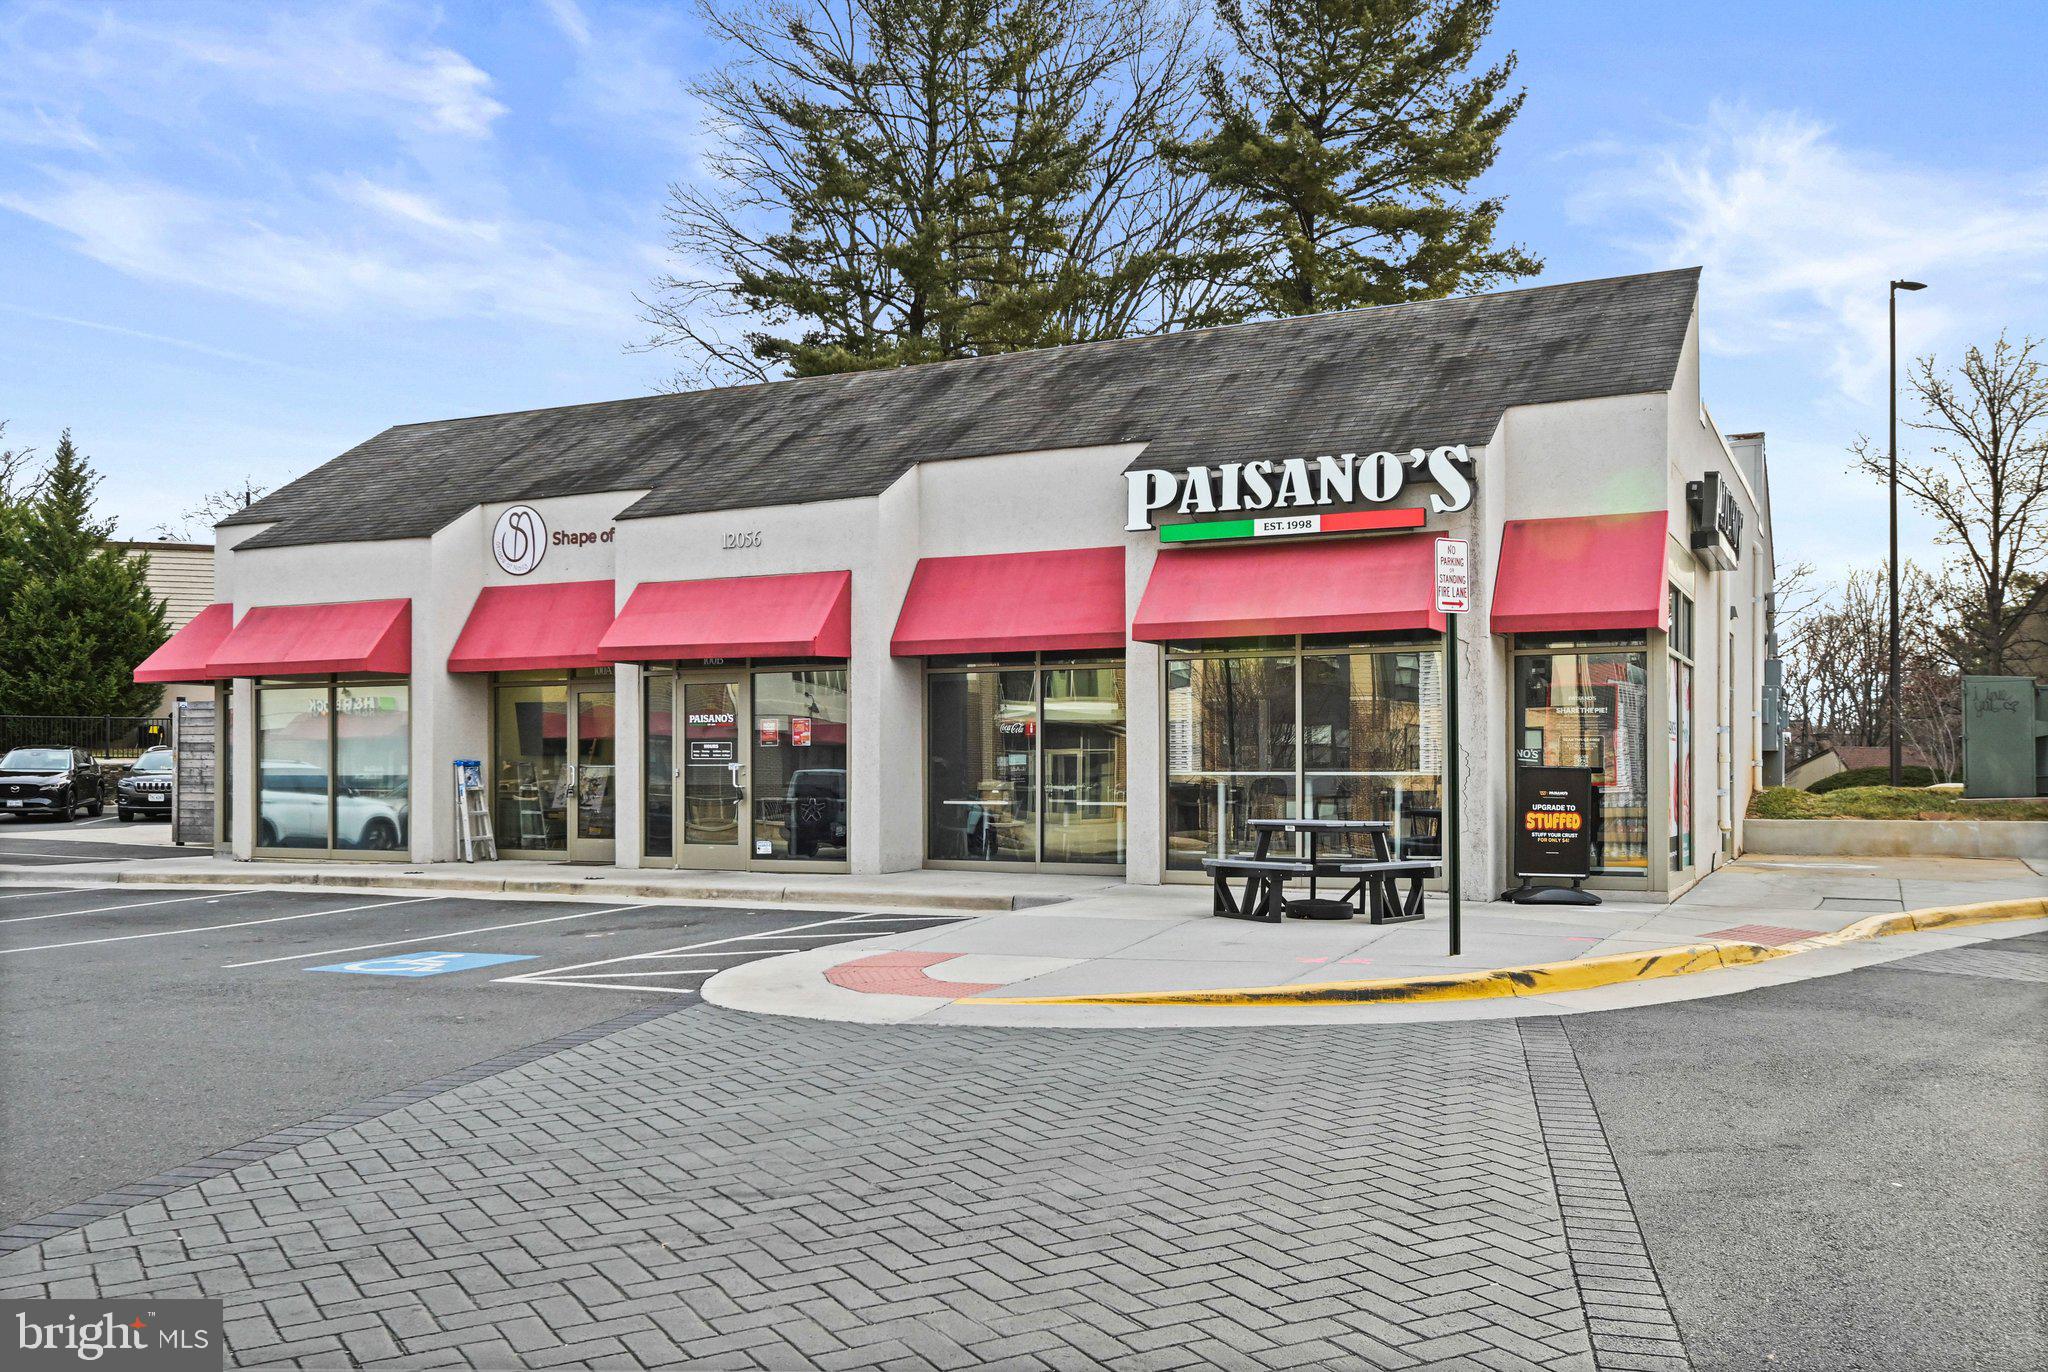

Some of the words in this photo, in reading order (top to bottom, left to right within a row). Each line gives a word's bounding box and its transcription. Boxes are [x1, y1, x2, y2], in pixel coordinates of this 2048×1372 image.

[1124, 444, 1472, 532] PAISANO'S
[1263, 522, 1285, 532] EST.
[1287, 520, 1312, 530] 1998
[552, 530, 597, 547] Shape
[600, 526, 616, 543] of
[722, 530, 762, 549] 12056
[1447, 545, 1456, 554] NO
[1440, 556, 1464, 567] PARKING
[1439, 574, 1466, 585] STANDING
[1438, 586, 1450, 597] FIRE
[1451, 586, 1467, 598] LANE
[689, 713, 734, 723] PAISANO'S
[1526, 812, 1581, 830] STUFFED
